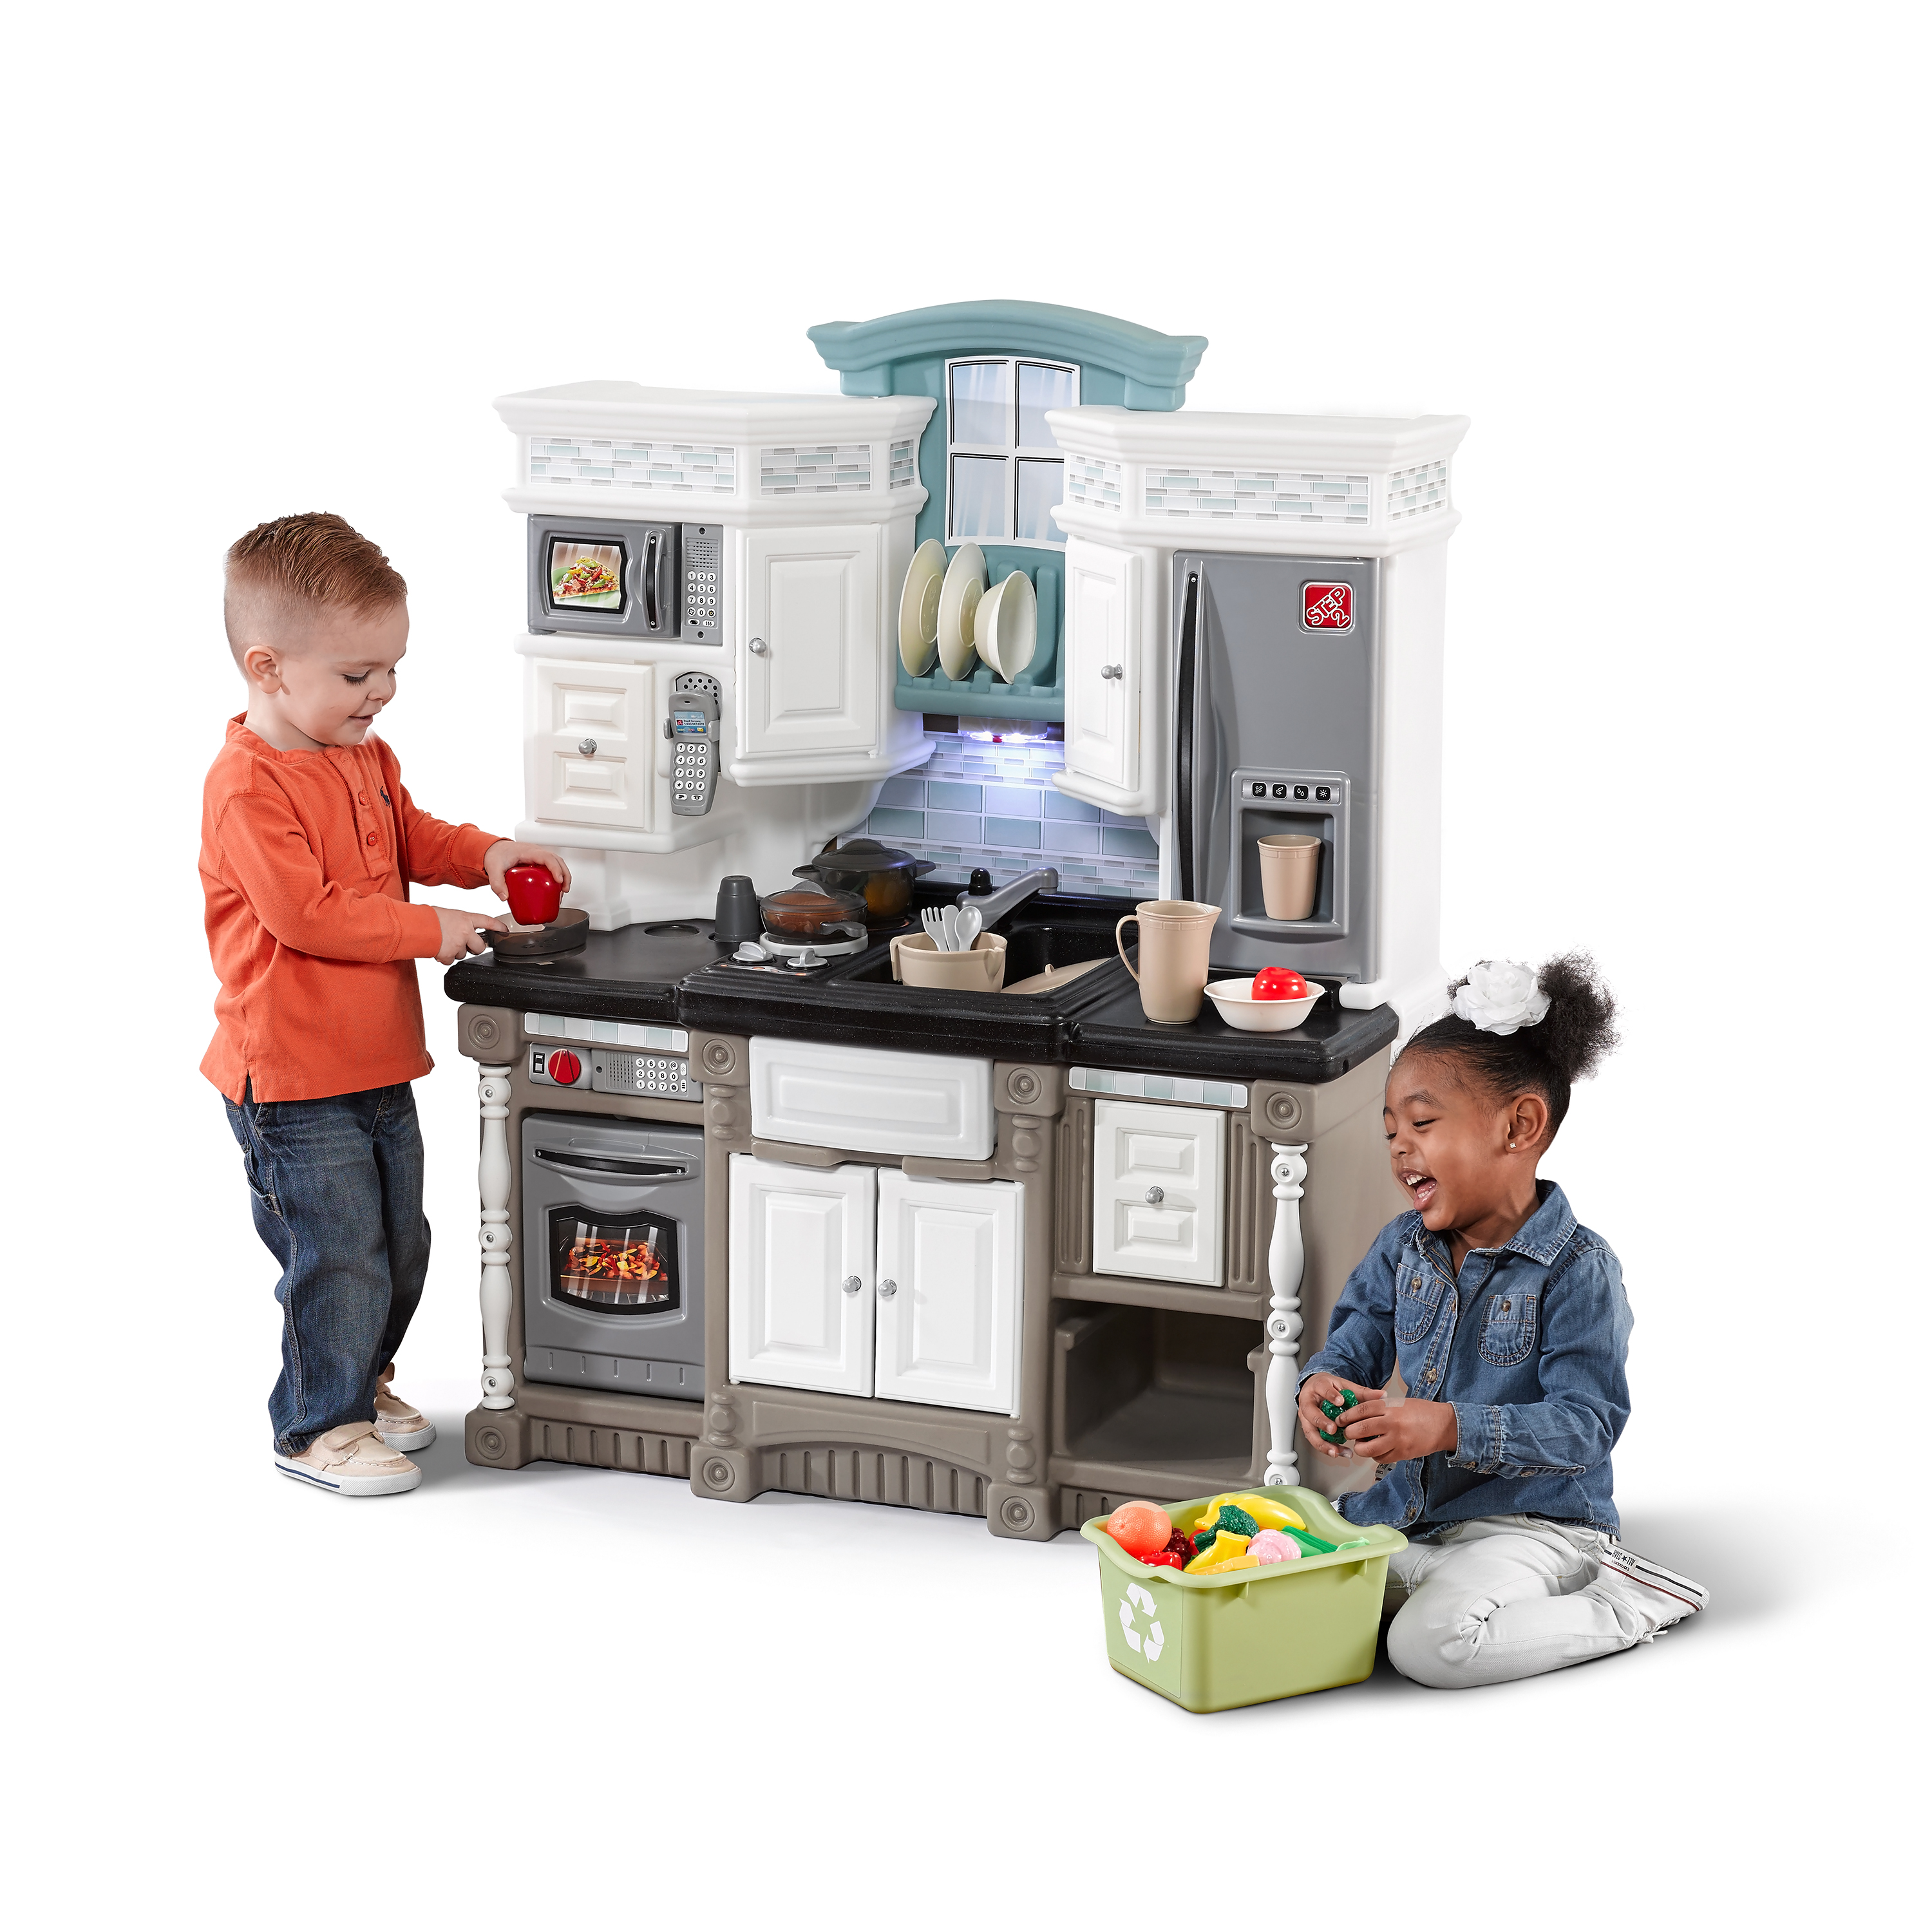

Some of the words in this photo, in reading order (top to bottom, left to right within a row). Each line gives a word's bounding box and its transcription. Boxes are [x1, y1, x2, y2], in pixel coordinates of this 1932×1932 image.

[1306, 586, 1345, 625] STEP
[1331, 609, 1350, 627] 2
[1612, 1549, 1622, 1560] STAR
[1627, 1557, 1636, 1566] ALL
